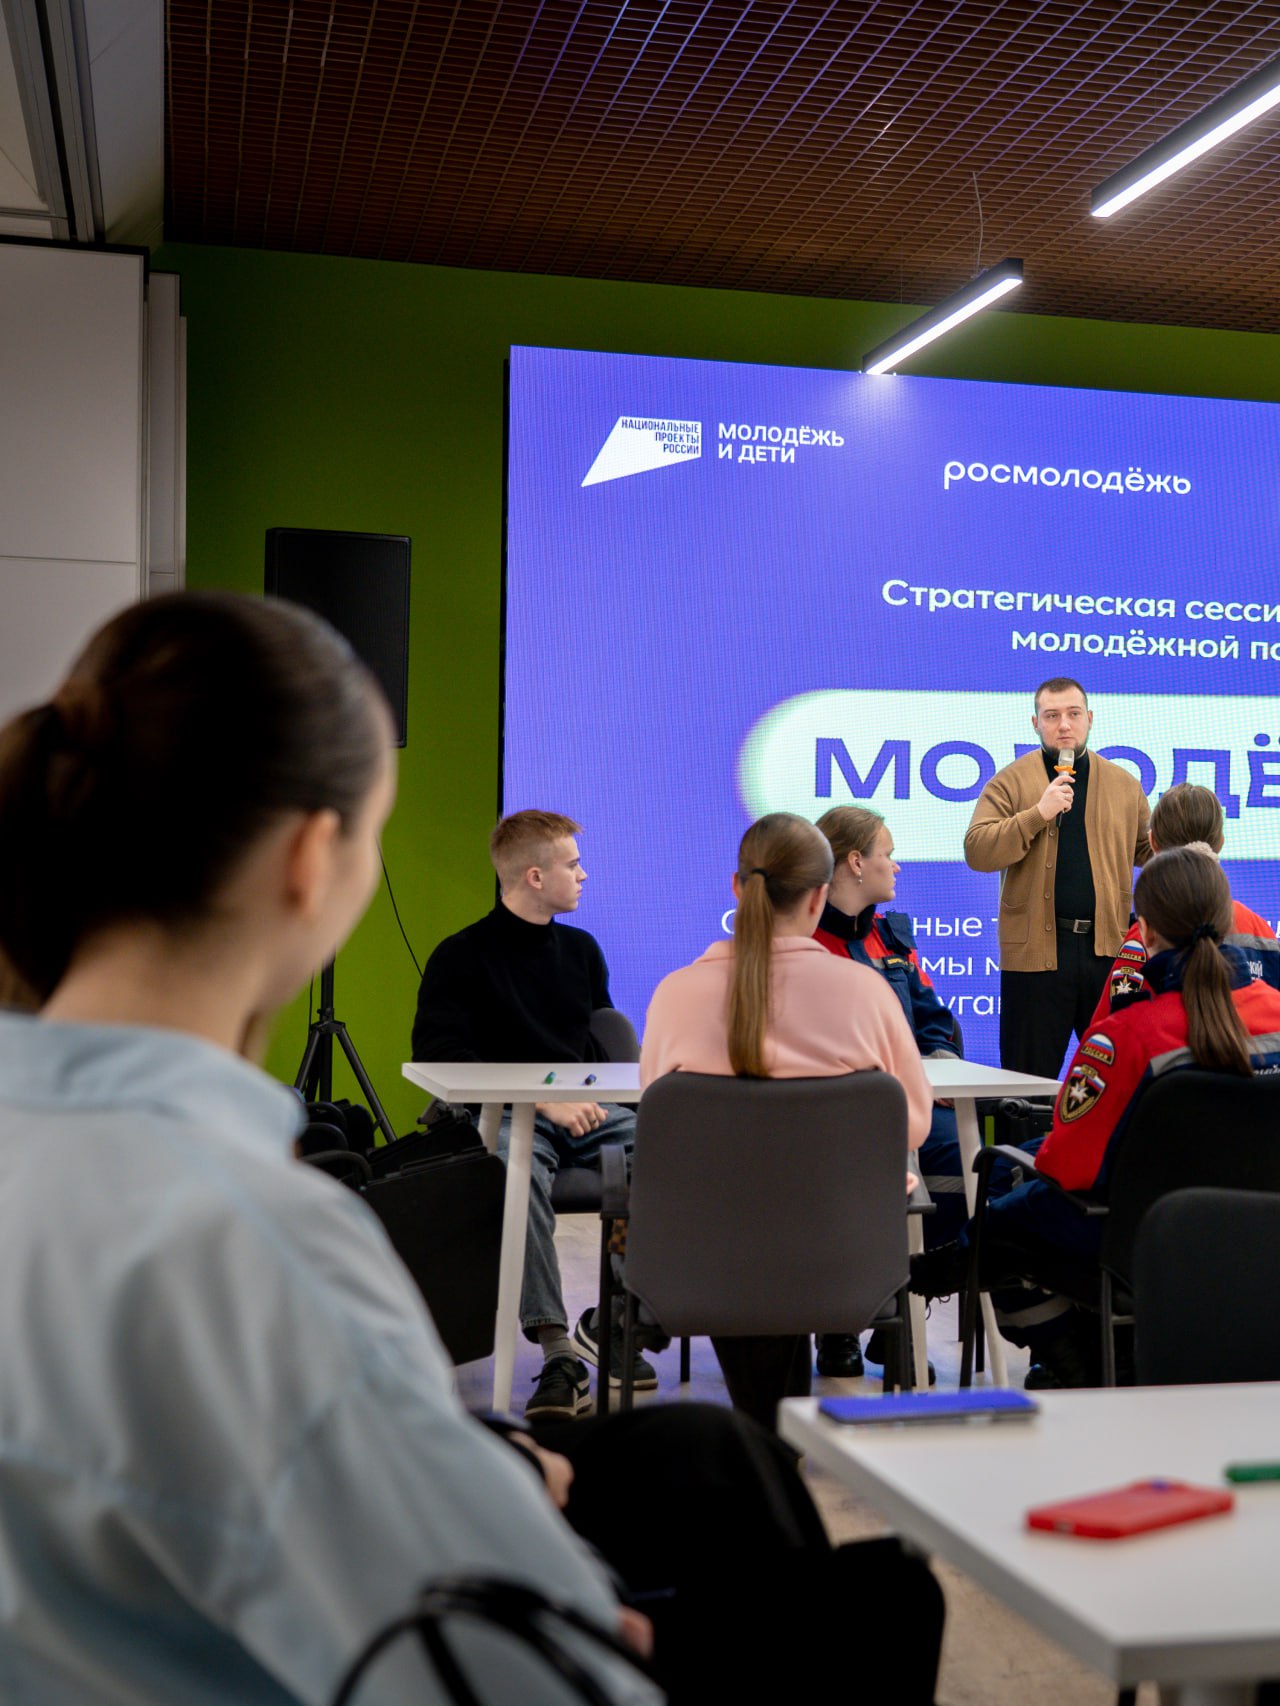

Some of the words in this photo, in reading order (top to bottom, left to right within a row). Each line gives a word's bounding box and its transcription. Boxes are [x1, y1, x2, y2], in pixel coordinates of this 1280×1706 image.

[621, 418, 700, 434] НАЦИОНАЛЬНЫЕ
[655, 431, 700, 444] ПРОЕКТЫ
[718, 422, 845, 448] МОЛОДЁЖЬ
[663, 443, 700, 455] РОССИИ
[718, 443, 733, 459] И
[738, 444, 795, 464] ДЕТИ
[943, 460, 1191, 495] росмолодёжь
[882, 579, 1176, 618] Стратегическая
[1012, 630, 1240, 660] молодёжной
